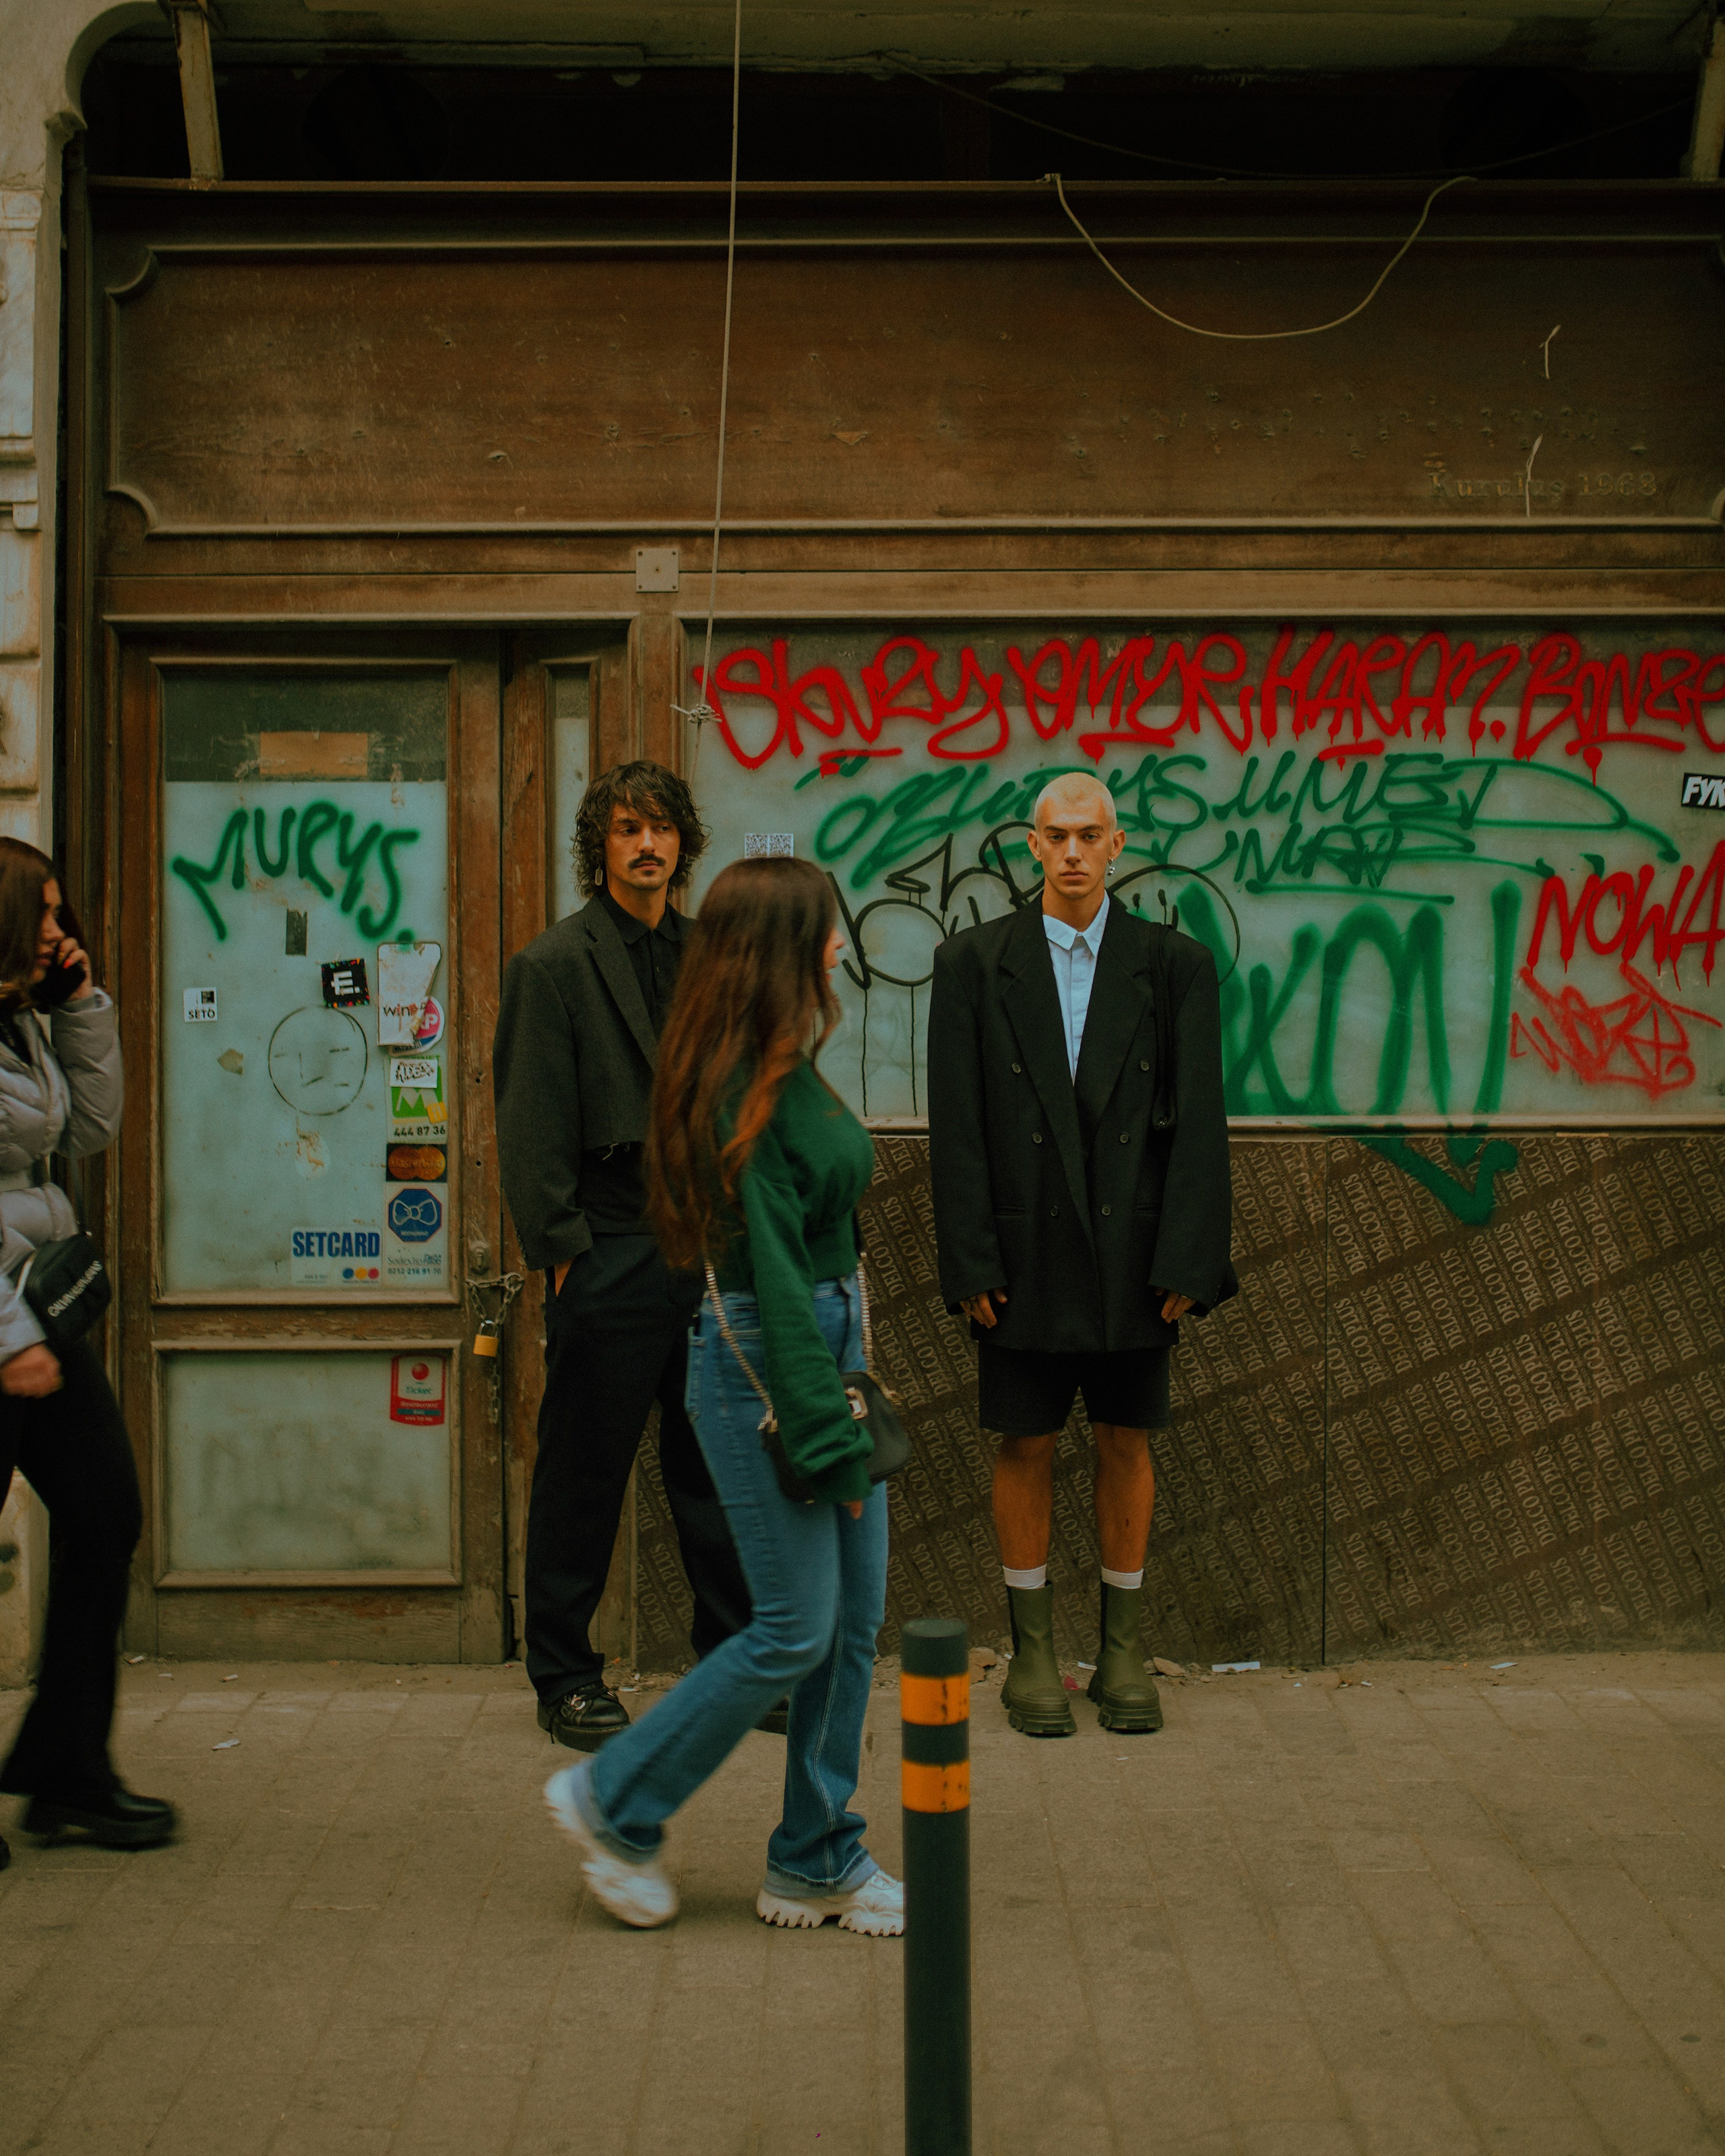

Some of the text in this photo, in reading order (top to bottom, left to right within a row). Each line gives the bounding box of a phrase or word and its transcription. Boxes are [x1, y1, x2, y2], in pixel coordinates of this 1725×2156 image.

[1579, 472, 1658, 497] 1968
[394, 1126, 446, 1137] 444 87 36
[1249, 1148, 1298, 1235] DELCO PLUS
[1342, 1174, 1392, 1261] DELCO PLUS
[1369, 1162, 1419, 1248] DELCO PLUS
[1601, 1174, 1651, 1261] DELCO PLUS
[1627, 1162, 1677, 1248] DELCO PLUS
[1654, 1149, 1704, 1236] DELCO PLUS
[292, 1232, 381, 1258] SETCARD
[881, 1197, 932, 1284] DELCO PLUS
[1468, 1236, 1517, 1323] DELCO PLUS
[1495, 1223, 1544, 1310] DELCO PLUS
[1521, 1211, 1571, 1298] DELCO PLUS
[1548, 1198, 1598, 1286] DELCO PLUS
[1591, 1224, 1624, 1273] DELCO
[1240, 1273, 1290, 1360] DELCO PLUS
[1267, 1261, 1317, 1348] DELCO PLUS
[1361, 1286, 1411, 1373] DELCO PLUS
[1387, 1273, 1438, 1360] DELCO PLUS
[1414, 1261, 1464, 1348] DELCO PLUS
[1441, 1248, 1491, 1335] DELCO PLUS
[1619, 1285, 1670, 1372] DELCO PLUS
[1646, 1272, 1697, 1360] DELCO PLUS
[873, 1321, 924, 1408] DELCO PLUS
[900, 1309, 950, 1396] DELCO PLUS
[944, 1334, 977, 1383] DELCO
[1334, 1298, 1384, 1385] DELCO PLUS
[1513, 1335, 1563, 1422] DELCO PLUS
[1540, 1322, 1590, 1409] DELCO PLUS
[1567, 1310, 1617, 1397] DELCO PLUS
[1593, 1298, 1643, 1385] DELCO PLUS
[1406, 1385, 1456, 1471] DELCO PLUS
[1433, 1372, 1483, 1459] DELCO PLUS
[1460, 1360, 1510, 1447] DELCO PLUS
[1486, 1348, 1537, 1434] DELCO PLUS
[1666, 1384, 1716, 1471] DELCO PLUS
[918, 1420, 947, 1456] PLUS
[1222, 1447, 1255, 1496] DELCO
[1249, 1434, 1282, 1484] DELCO
[1326, 1422, 1376, 1509] DELCO PLUS
[1352, 1409, 1403, 1496] DELCO PLUS
[1379, 1397, 1429, 1484] DELCO PLUS
[1559, 1434, 1609, 1521] DELCO PLUS
[1586, 1422, 1635, 1509] DELCO PLUS
[1612, 1409, 1662, 1496] DELCO PLUS
[1639, 1397, 1689, 1484] DELCO PLUS
[1424, 1496, 1453, 1531] PLUS
[1452, 1484, 1502, 1571] DELCO PLUS
[1478, 1471, 1529, 1558] DELCO PLUS
[1505, 1458, 1555, 1546] DELCO PLUS
[1532, 1447, 1582, 1533] DELCO PLUS
[1344, 1533, 1394, 1620] DELCO PLUS
[1604, 1533, 1654, 1620] DELCO PLUS
[1631, 1520, 1681, 1608] DELCO PLUS
